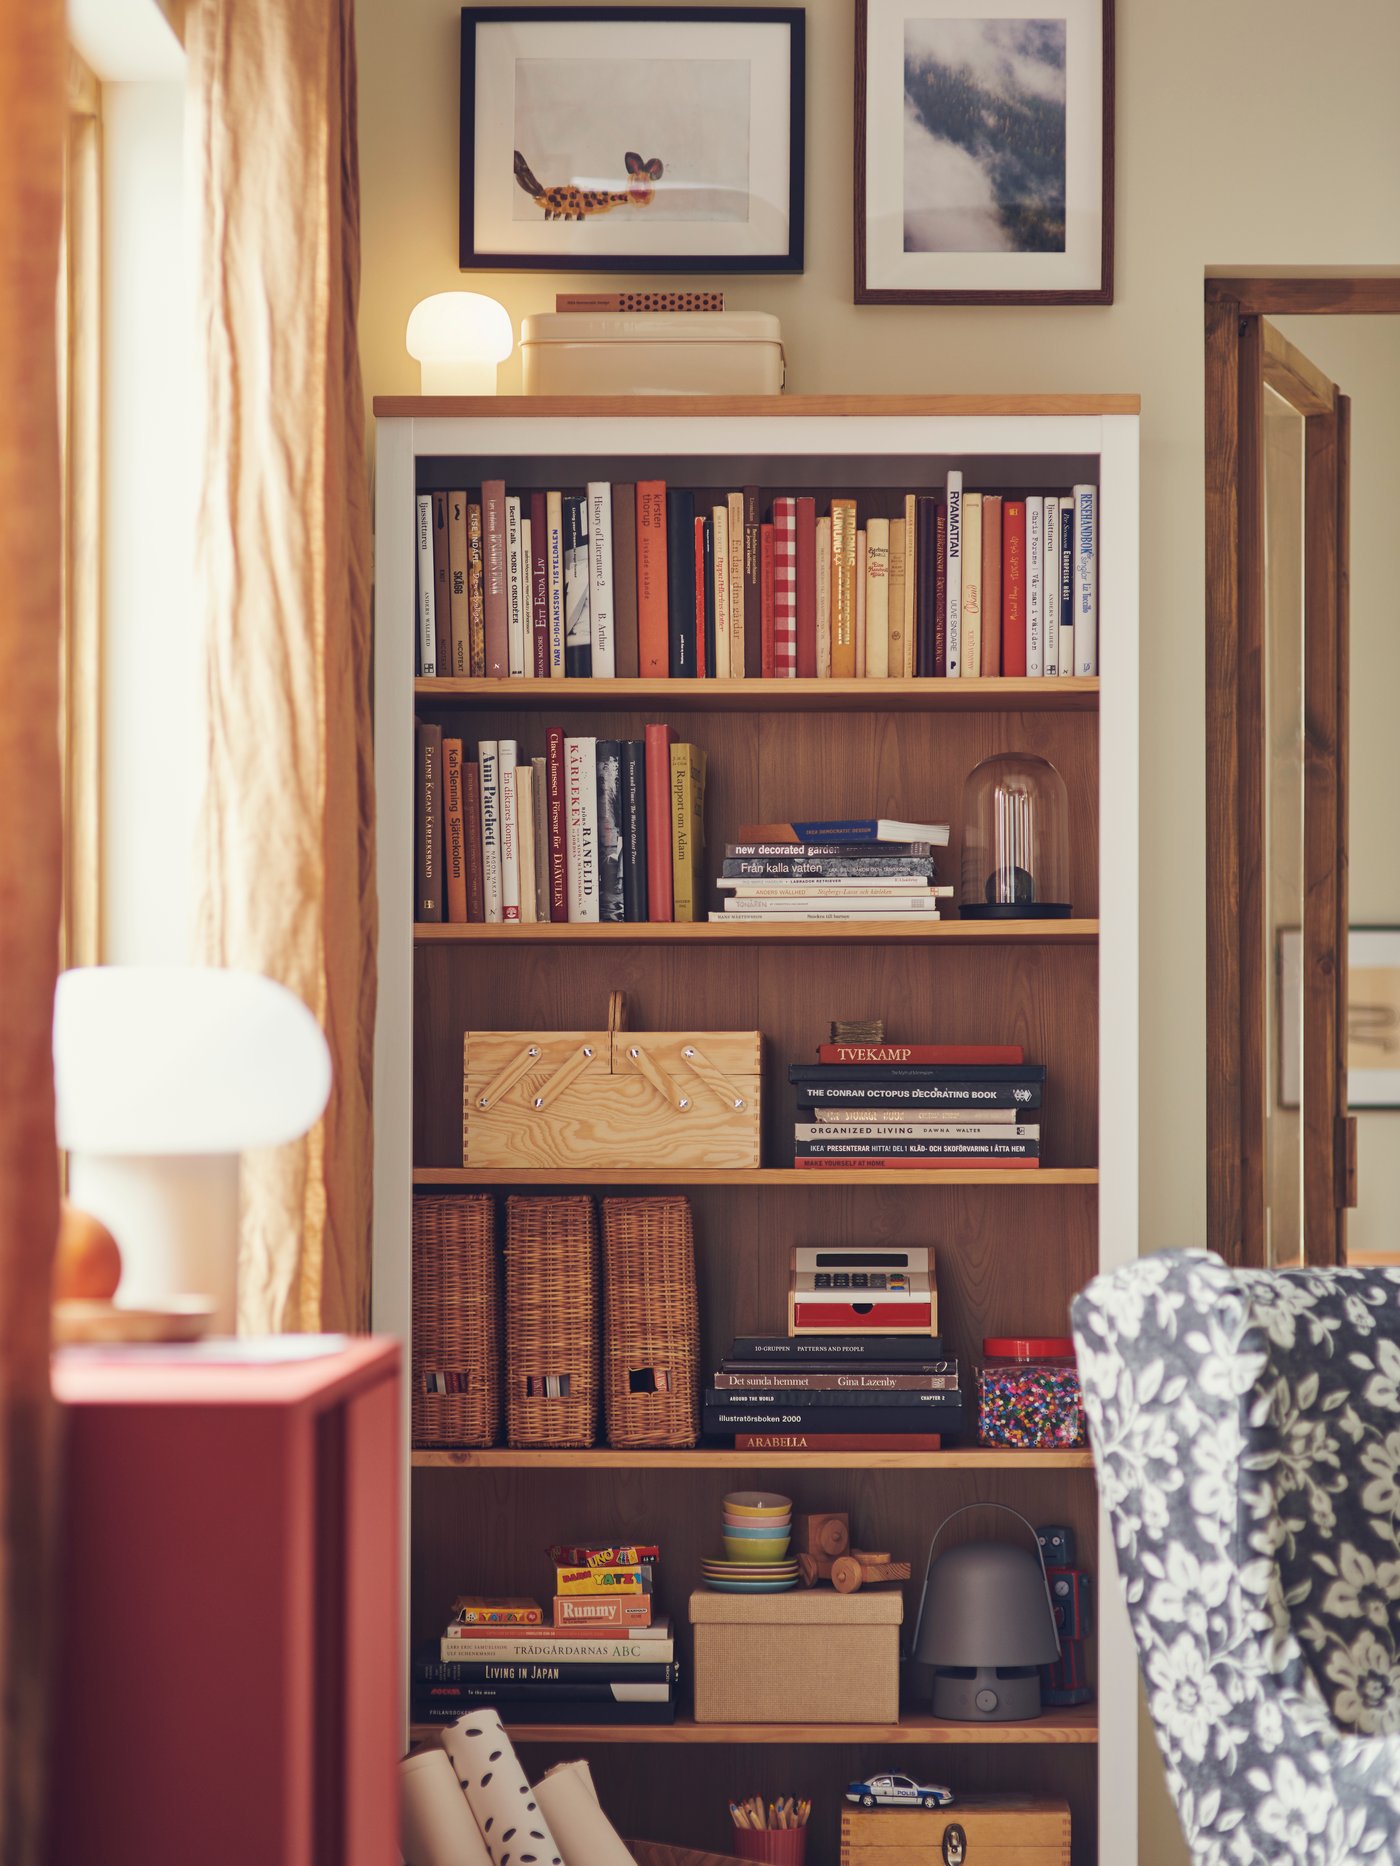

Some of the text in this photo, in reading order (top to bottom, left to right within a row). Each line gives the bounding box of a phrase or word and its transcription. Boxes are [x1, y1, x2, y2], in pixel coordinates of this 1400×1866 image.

[641, 493, 652, 527] thorup
[653, 494, 663, 529] kirsten
[419, 502, 429, 550] ljussättaren
[845, 507, 856, 567] JUDARNAS
[1045, 504, 1055, 552] ljussättaren
[1080, 493, 1093, 555] RESEHANDBOK
[509, 505, 518, 583] Bertil Falk MORD &
[552, 529, 560, 585] TISTELDALEN
[732, 539, 742, 553] En
[592, 495, 607, 652] History of Literature B. Arthur
[716, 556, 725, 580] Pappa
[731, 555, 742, 574] dag
[949, 491, 960, 652] RYAMATTAN SNIDARE
[1076, 556, 1092, 581] singlar
[453, 570, 465, 594] SKÄGG
[732, 581, 743, 605] dina
[1031, 573, 1040, 589] Vår
[1082, 583, 1092, 592] Liz
[553, 589, 561, 647] LO-JOHANSSON
[718, 610, 726, 633] dotter
[730, 607, 743, 640] gårdar
[1031, 617, 1039, 651] världen
[550, 733, 559, 759] Claes
[482, 751, 496, 783] Ann
[551, 759, 560, 796] Janssen
[570, 744, 583, 826] KÄRLEKEN
[673, 770, 686, 811] Rapport
[483, 786, 497, 846] Patchett
[503, 772, 514, 861] En diktares kompost
[552, 800, 561, 834] Försvar
[677, 812, 685, 828] om
[450, 817, 461, 878] Sjättekolonn
[553, 836, 562, 849] för
[677, 830, 688, 861] Adam
[735, 844, 840, 856] new decorated garden
[582, 827, 593, 896] RANELID
[741, 862, 764, 873] Från
[766, 862, 789, 873] kalla
[791, 863, 823, 873] vatten
[837, 1048, 912, 1061] TVEKAMP
[806, 1089, 997, 1099] THE CONRAN OCTOPUS DECORATING BOOK
[943, 1144, 989, 1153] SKOFÖRVARING
[994, 1144, 1010, 1153] ÅTTA
[1011, 1145, 1026, 1153] HEM
[842, 1345, 865, 1353] PEOPLE
[729, 1376, 897, 1389] Det sunda hemmet Gina Lazenby
[718, 1414, 802, 1423] illustratörsboken 2000
[747, 1437, 808, 1448] ARABELLA
[586, 1548, 615, 1568] UNO
[562, 1602, 617, 1620] Rummy
[513, 1645, 641, 1657] TRÄDGÅRDARNAS ABC
